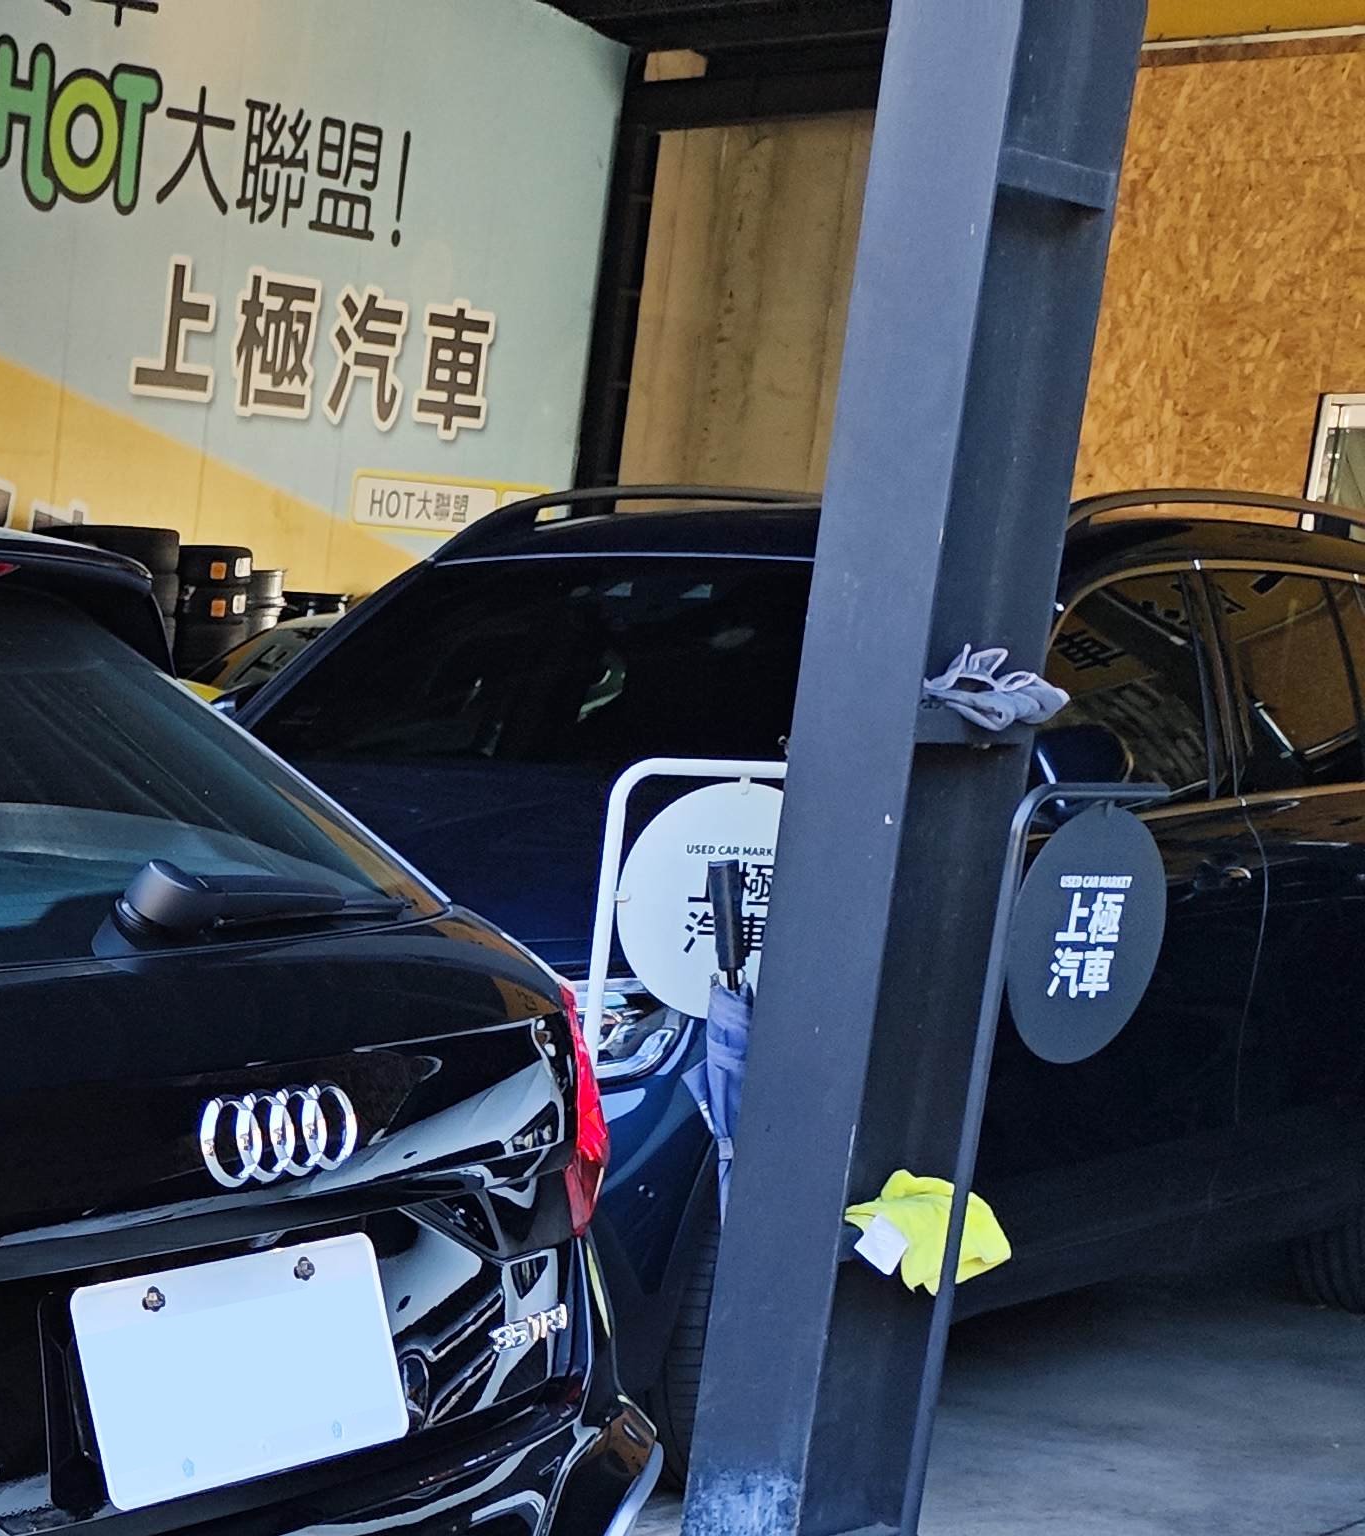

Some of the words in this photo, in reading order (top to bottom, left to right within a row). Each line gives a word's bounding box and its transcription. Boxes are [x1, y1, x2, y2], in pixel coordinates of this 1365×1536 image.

[132, 260, 496, 435] 上極汽車
[686, 844, 716, 855] USED
[718, 845, 740, 856] CAR
[743, 847, 774, 857] MARK
[1055, 891, 1126, 944] 上極
[1046, 946, 1115, 999] 汽車
